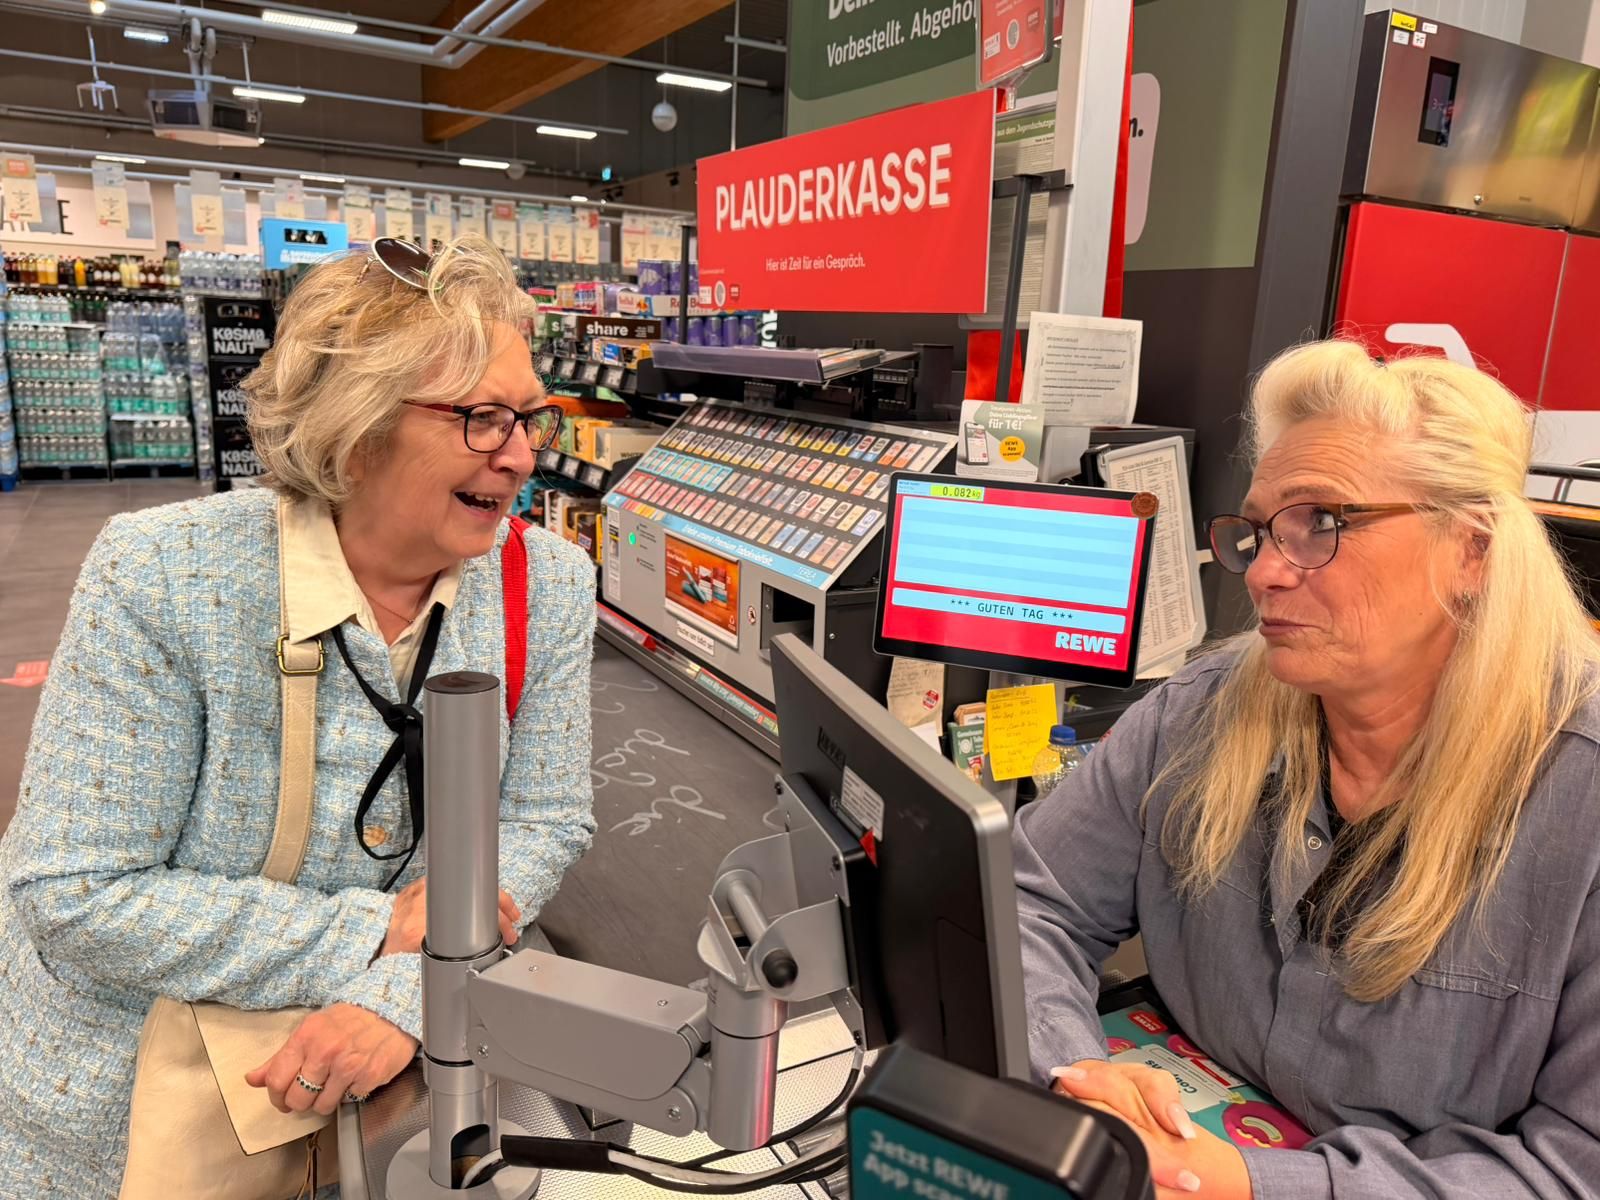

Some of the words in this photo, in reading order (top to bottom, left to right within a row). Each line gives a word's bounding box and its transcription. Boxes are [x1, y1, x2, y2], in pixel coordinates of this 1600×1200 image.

[826, 19, 905, 67] Vorbestellt.
[910, 0, 976, 40] Abgehol
[714, 142, 953, 233] PLAUDERKASSE
[765, 256, 779, 272] Hier
[779, 256, 788, 271] ist
[788, 256, 802, 271] Zeit
[803, 255, 812, 270] für
[813, 255, 825, 270] ein
[825, 251, 866, 272] Gespräch.
[586, 321, 629, 336] share
[214, 342, 257, 354] NAUT
[988, 418, 1003, 429] für
[942, 486, 972, 498] 0.082
[972, 491, 981, 500] kg
[976, 602, 1014, 616] GUTEN
[1022, 608, 1044, 620] TAG
[1055, 631, 1117, 656] REWE
[1145, 1060, 1198, 1094] Couns
[863, 1153, 909, 1189] App
[870, 1129, 930, 1173] Jetzt
[933, 1157, 1009, 1200] REWE
